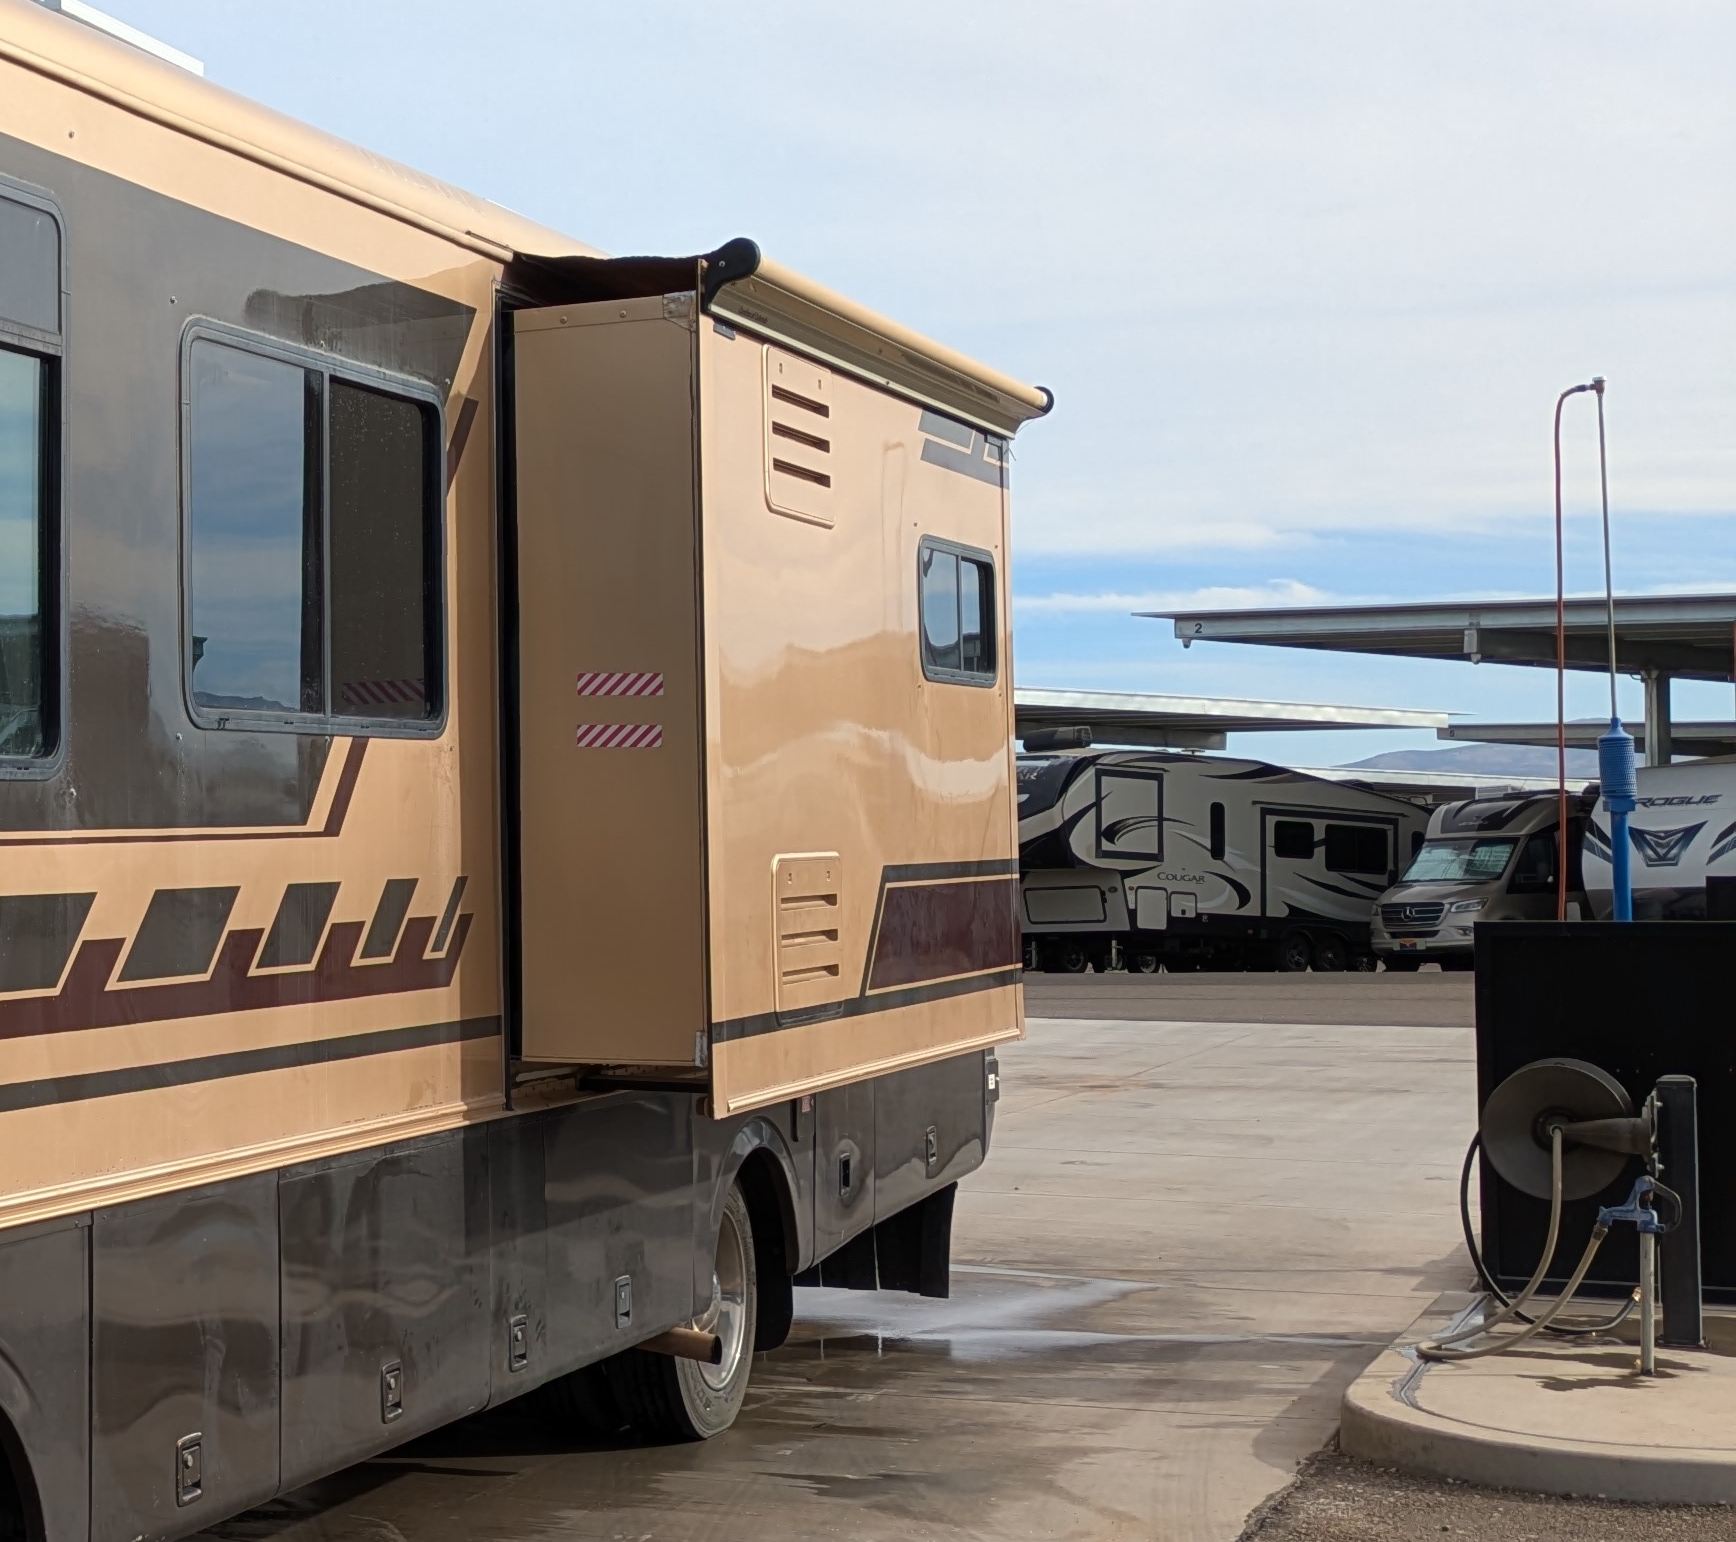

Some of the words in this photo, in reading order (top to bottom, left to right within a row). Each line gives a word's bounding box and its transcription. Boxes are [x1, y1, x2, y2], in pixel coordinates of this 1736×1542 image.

[1195, 623, 1203, 634] 2
[1635, 794, 1723, 808] ROGUE
[1157, 871, 1206, 883] COUGAR
